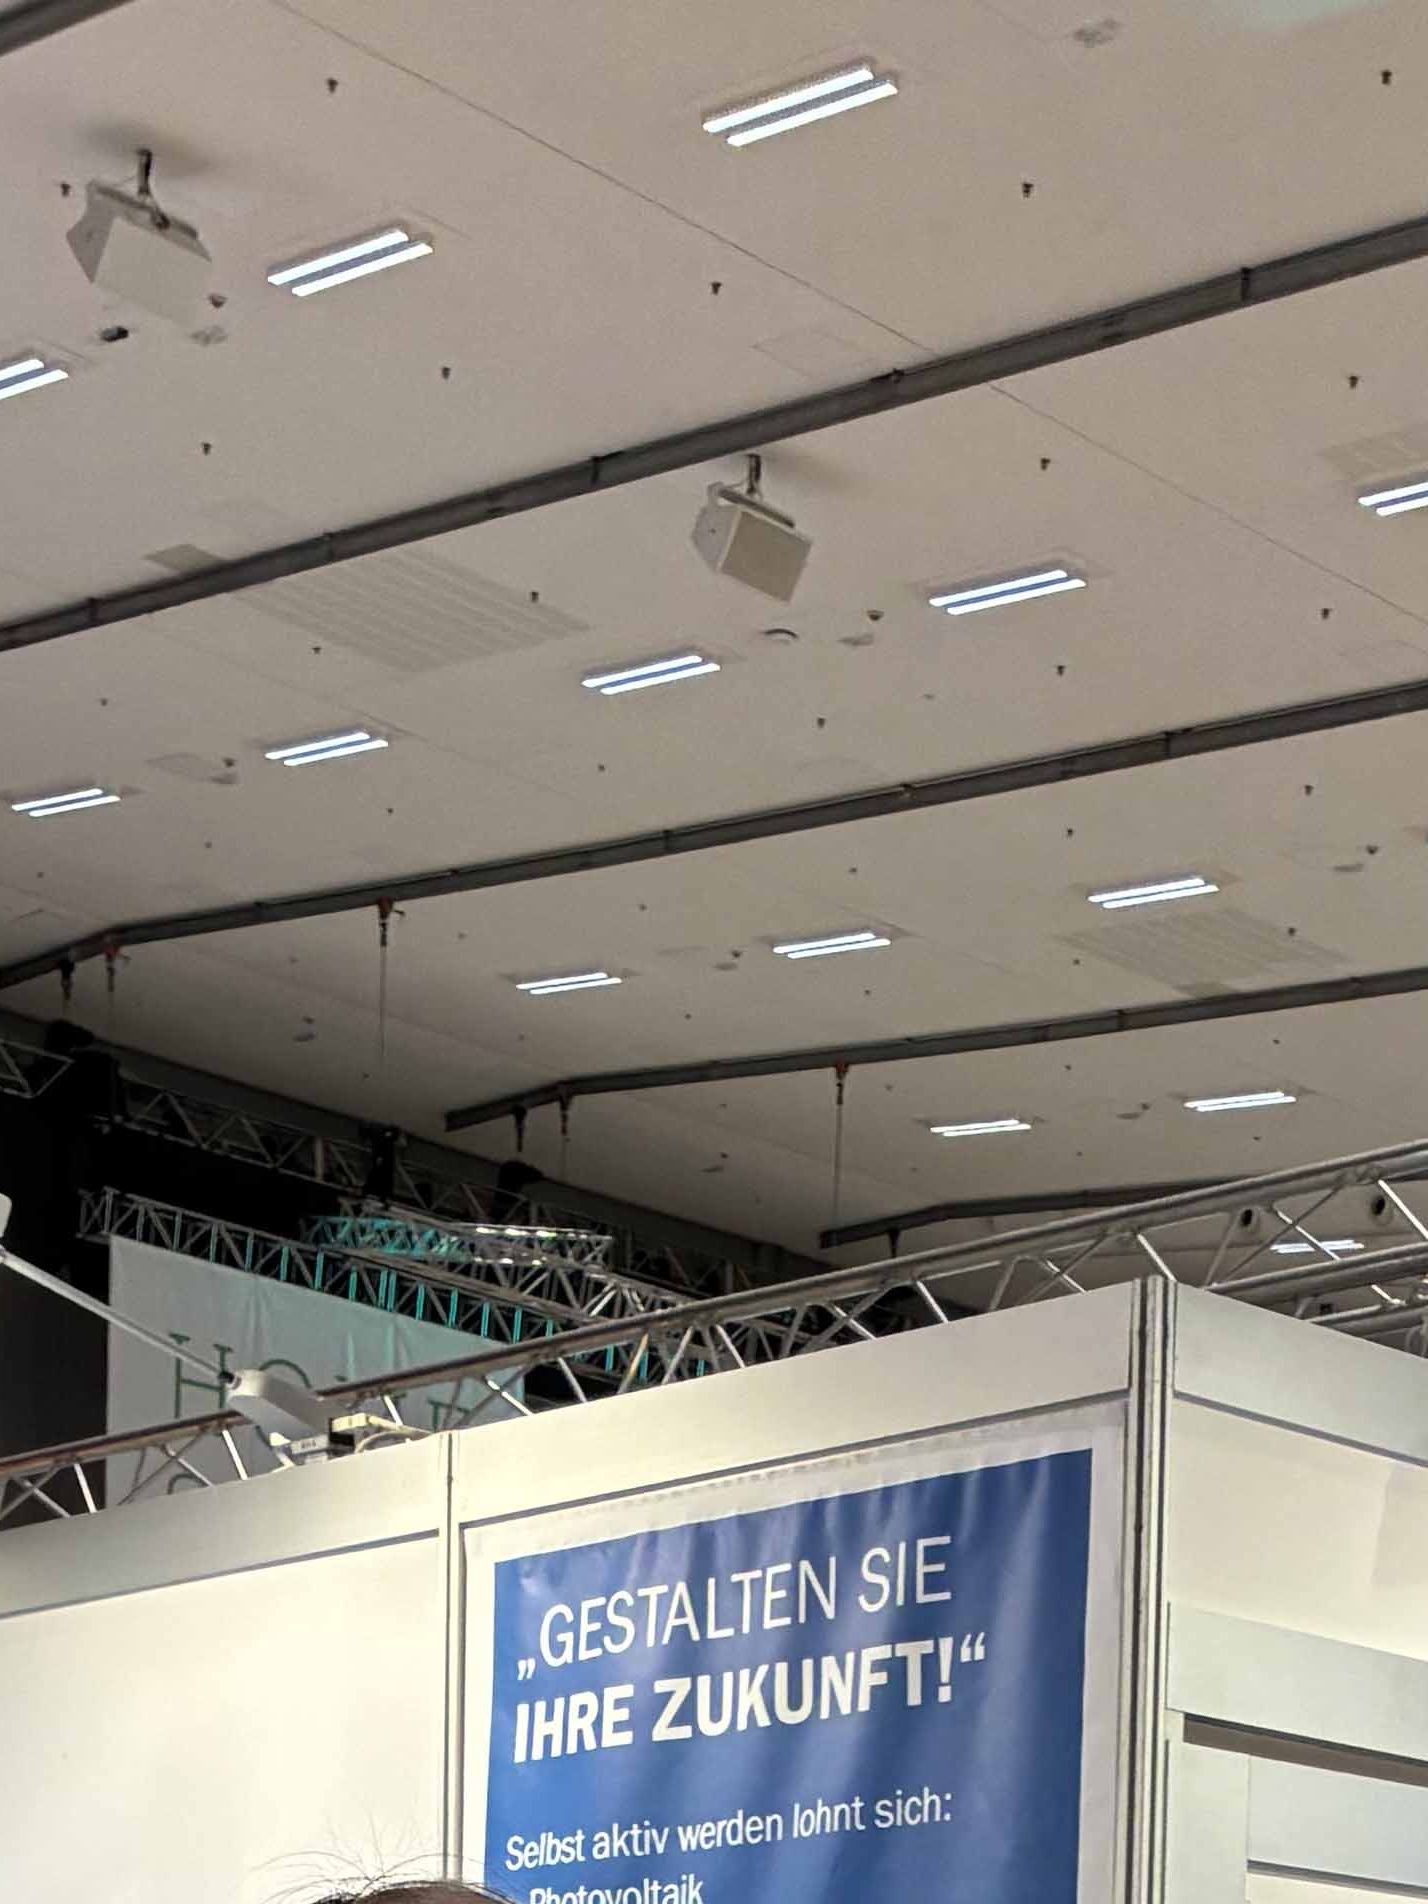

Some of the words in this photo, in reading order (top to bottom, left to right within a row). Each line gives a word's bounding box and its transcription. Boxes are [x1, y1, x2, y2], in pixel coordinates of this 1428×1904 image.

[517, 1556, 837, 1680] „GESTALTEN
[858, 1536, 951, 1614] SIE
[513, 1684, 634, 1763] IHRE
[652, 1632, 986, 1743] ZUKUNFT!“
[505, 1828, 585, 1871] Selbst
[592, 1823, 670, 1860] aktiv
[678, 1812, 783, 1852] werden
[792, 1796, 864, 1839] lohnt
[874, 1787, 952, 1829] sich:
